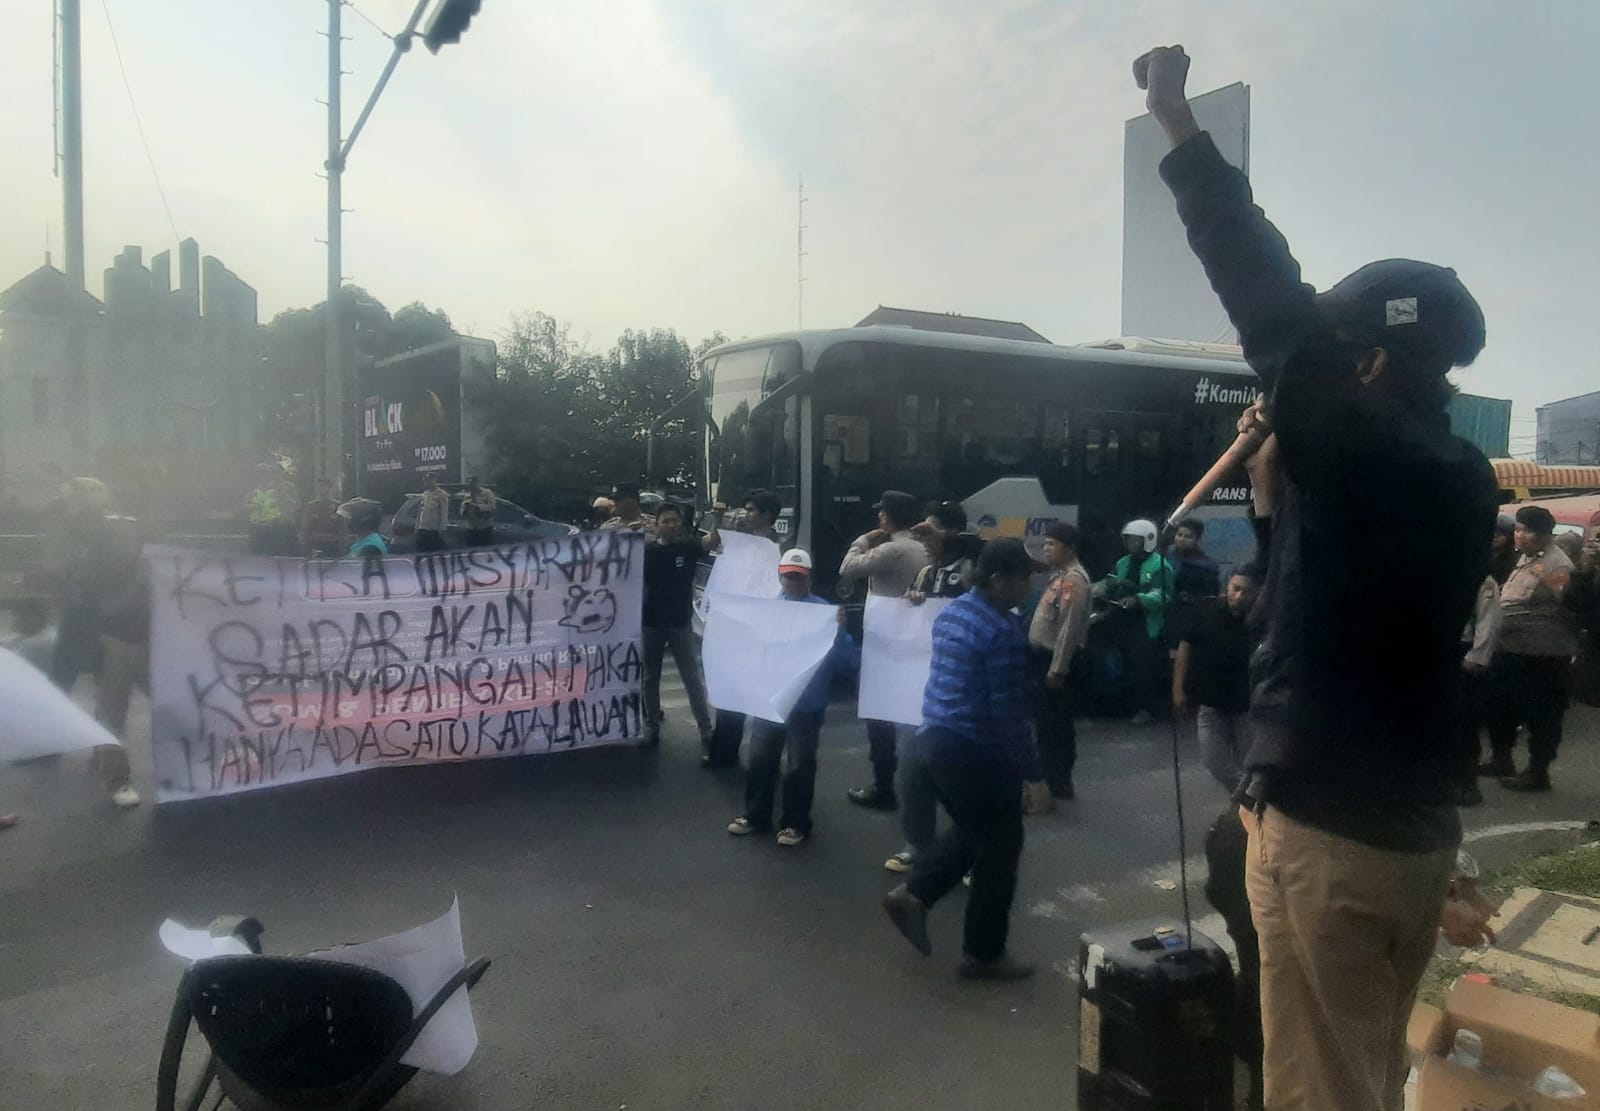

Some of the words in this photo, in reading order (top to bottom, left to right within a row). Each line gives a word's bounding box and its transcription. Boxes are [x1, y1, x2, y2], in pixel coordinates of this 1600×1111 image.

[777, 521, 788, 532] 07
[208, 609, 408, 697] SADAR
[424, 588, 534, 663] AKAN
